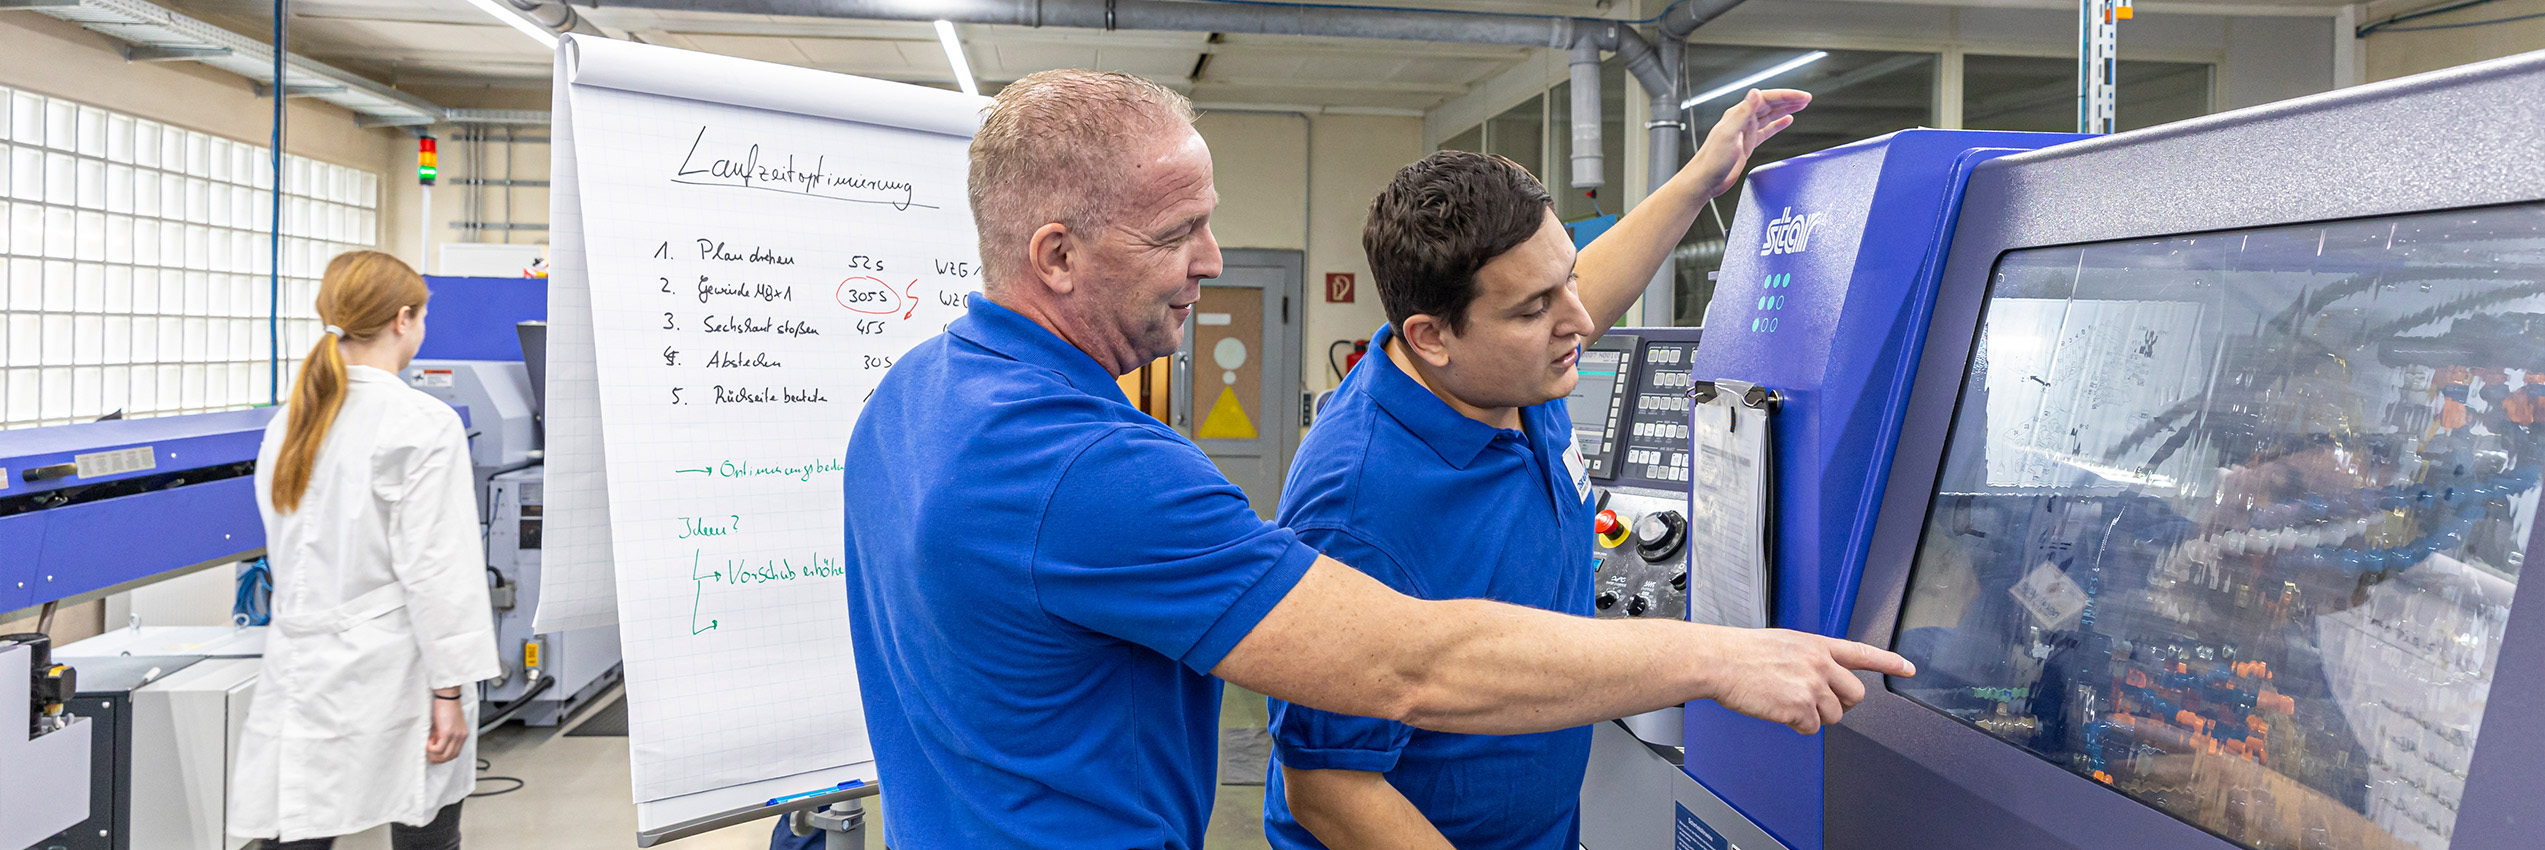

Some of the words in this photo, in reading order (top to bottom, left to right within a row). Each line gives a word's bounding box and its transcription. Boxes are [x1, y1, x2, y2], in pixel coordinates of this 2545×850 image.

[678, 126, 912, 211] Laufzeitoptimierung
[1760, 206, 1822, 256] star
[654, 240, 674, 260] 1.
[660, 277, 676, 295] 2.
[698, 274, 750, 304] Gewinde
[663, 312, 680, 331] 3.
[703, 315, 773, 334] Sechskant
[706, 350, 782, 369] Abstechen
[672, 387, 688, 405] 5.
[713, 384, 780, 405] Rückseite
[728, 558, 797, 585] Vorschub
[802, 551, 845, 578] erhöhe
